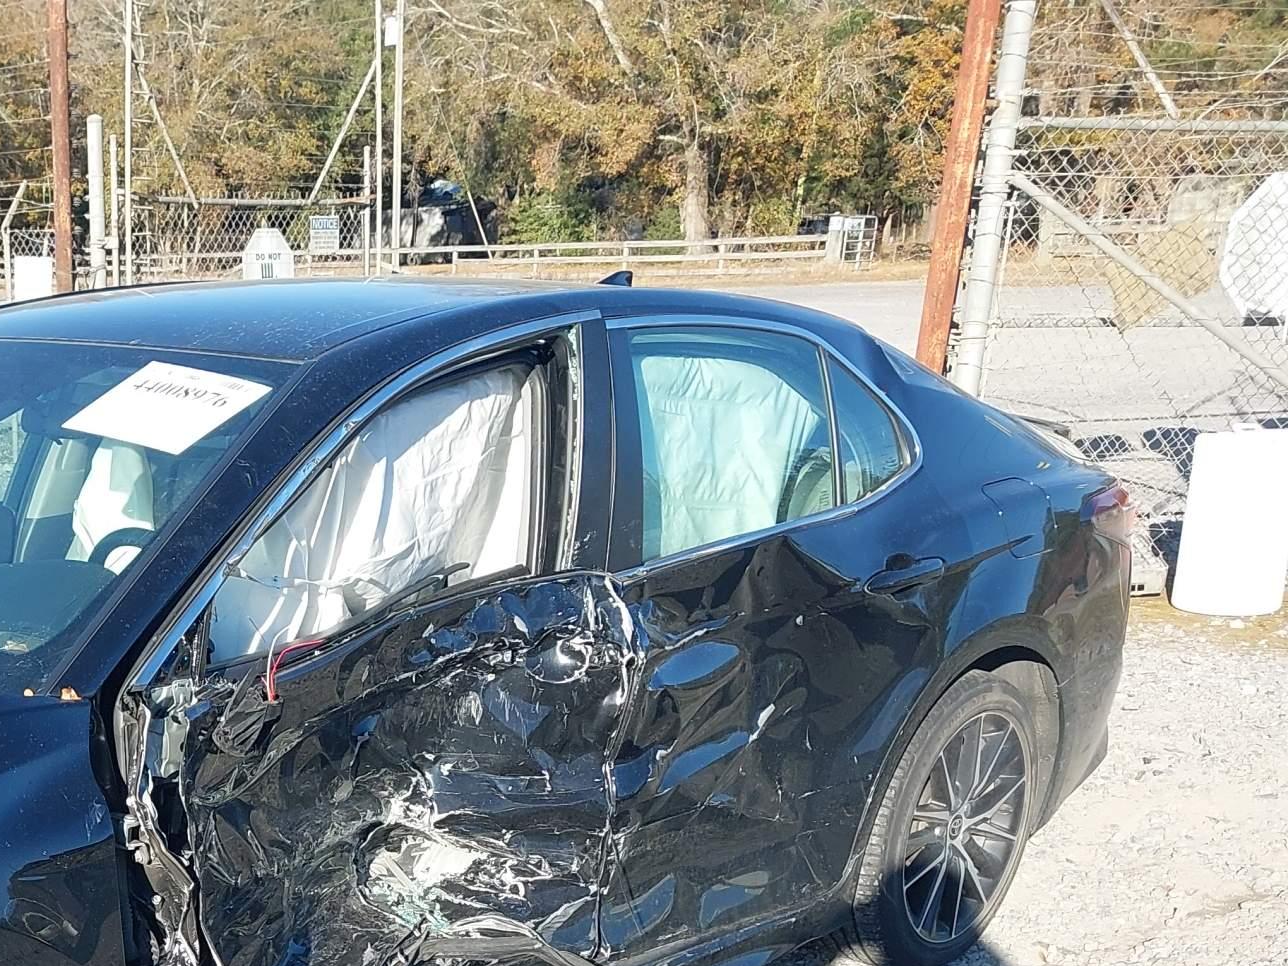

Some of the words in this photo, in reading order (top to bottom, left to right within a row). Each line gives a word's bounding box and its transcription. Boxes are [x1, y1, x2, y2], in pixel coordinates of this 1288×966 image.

[312, 218, 338, 230] NOTICE
[255, 253, 266, 261] DO
[268, 253, 282, 261] NOT
[132, 378, 229, 408] 44008976
